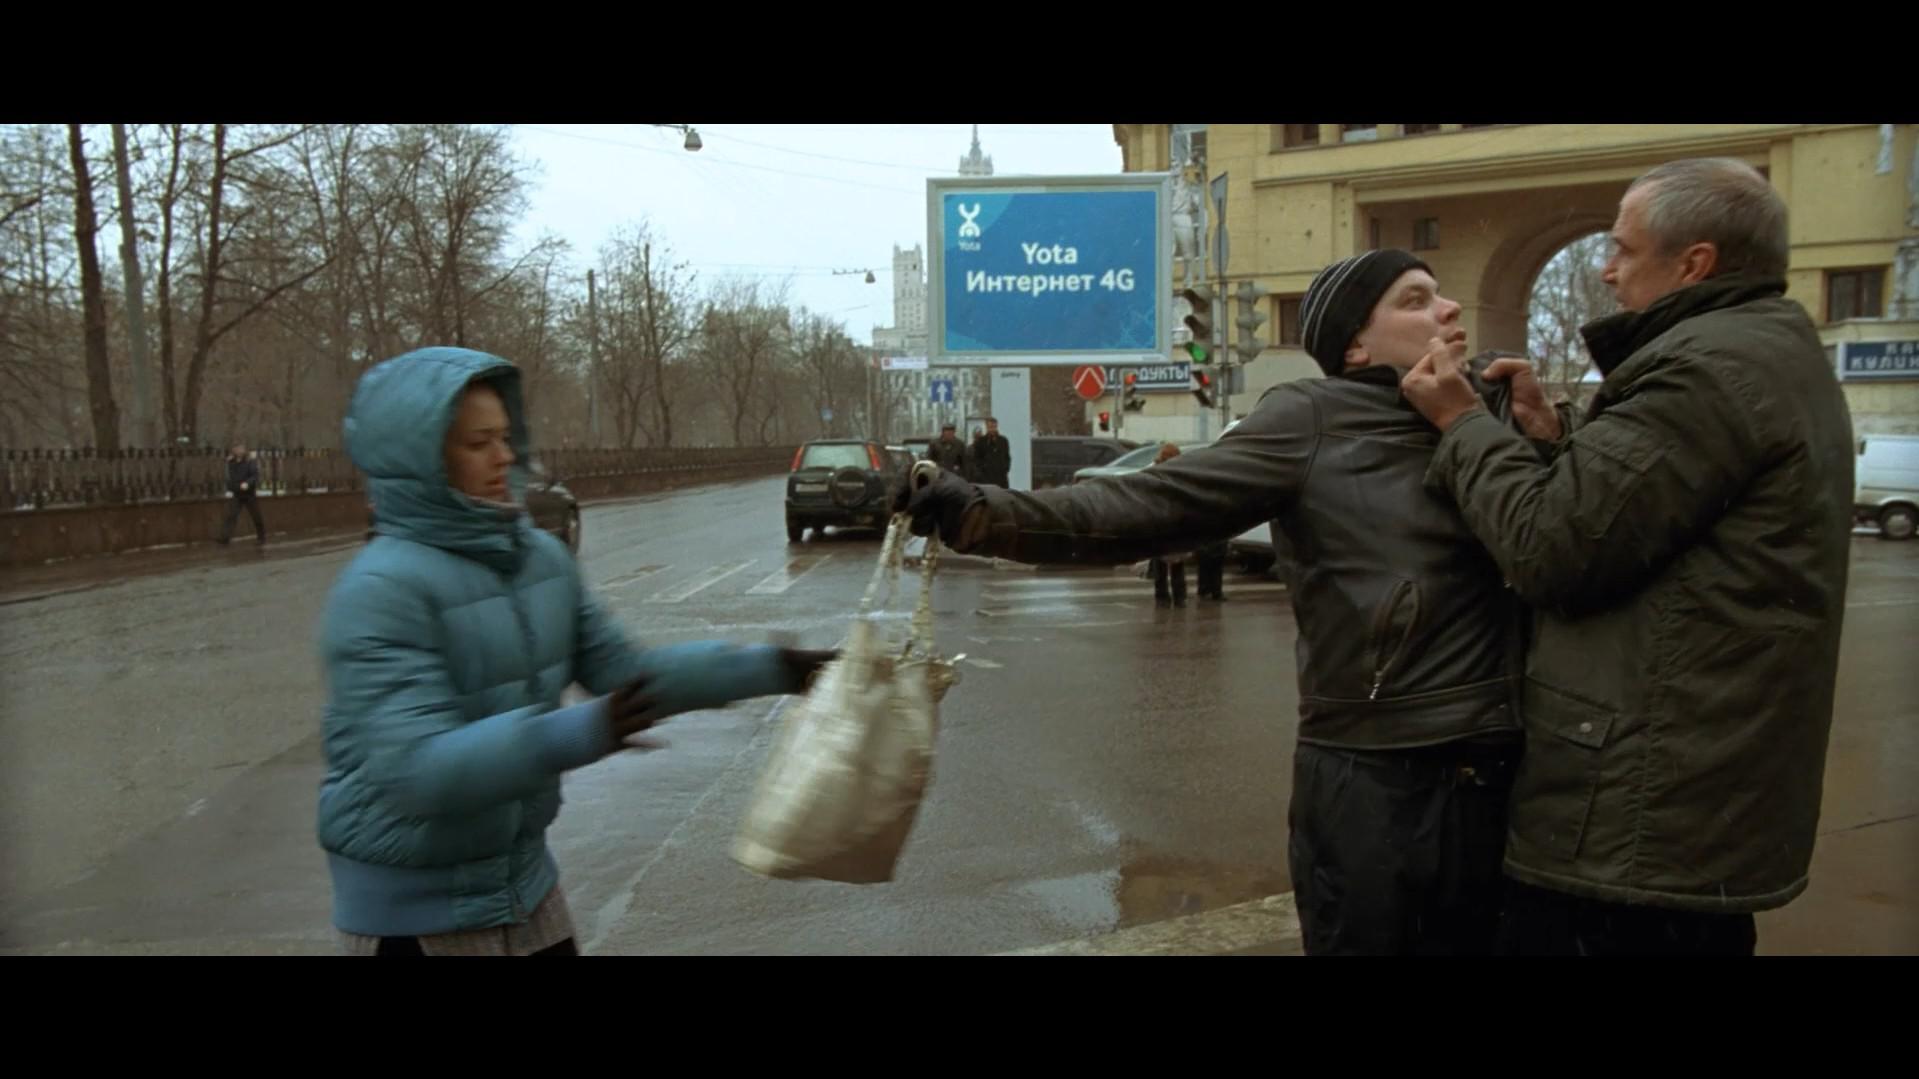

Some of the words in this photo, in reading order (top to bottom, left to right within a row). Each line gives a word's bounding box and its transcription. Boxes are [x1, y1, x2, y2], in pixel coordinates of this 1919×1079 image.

[957, 239, 982, 251] Yota
[1021, 242, 1078, 265] Yota
[966, 270, 1095, 297] Интернет
[1099, 268, 1135, 291] 4G
[1108, 364, 1190, 382] ПДУКТЫ
